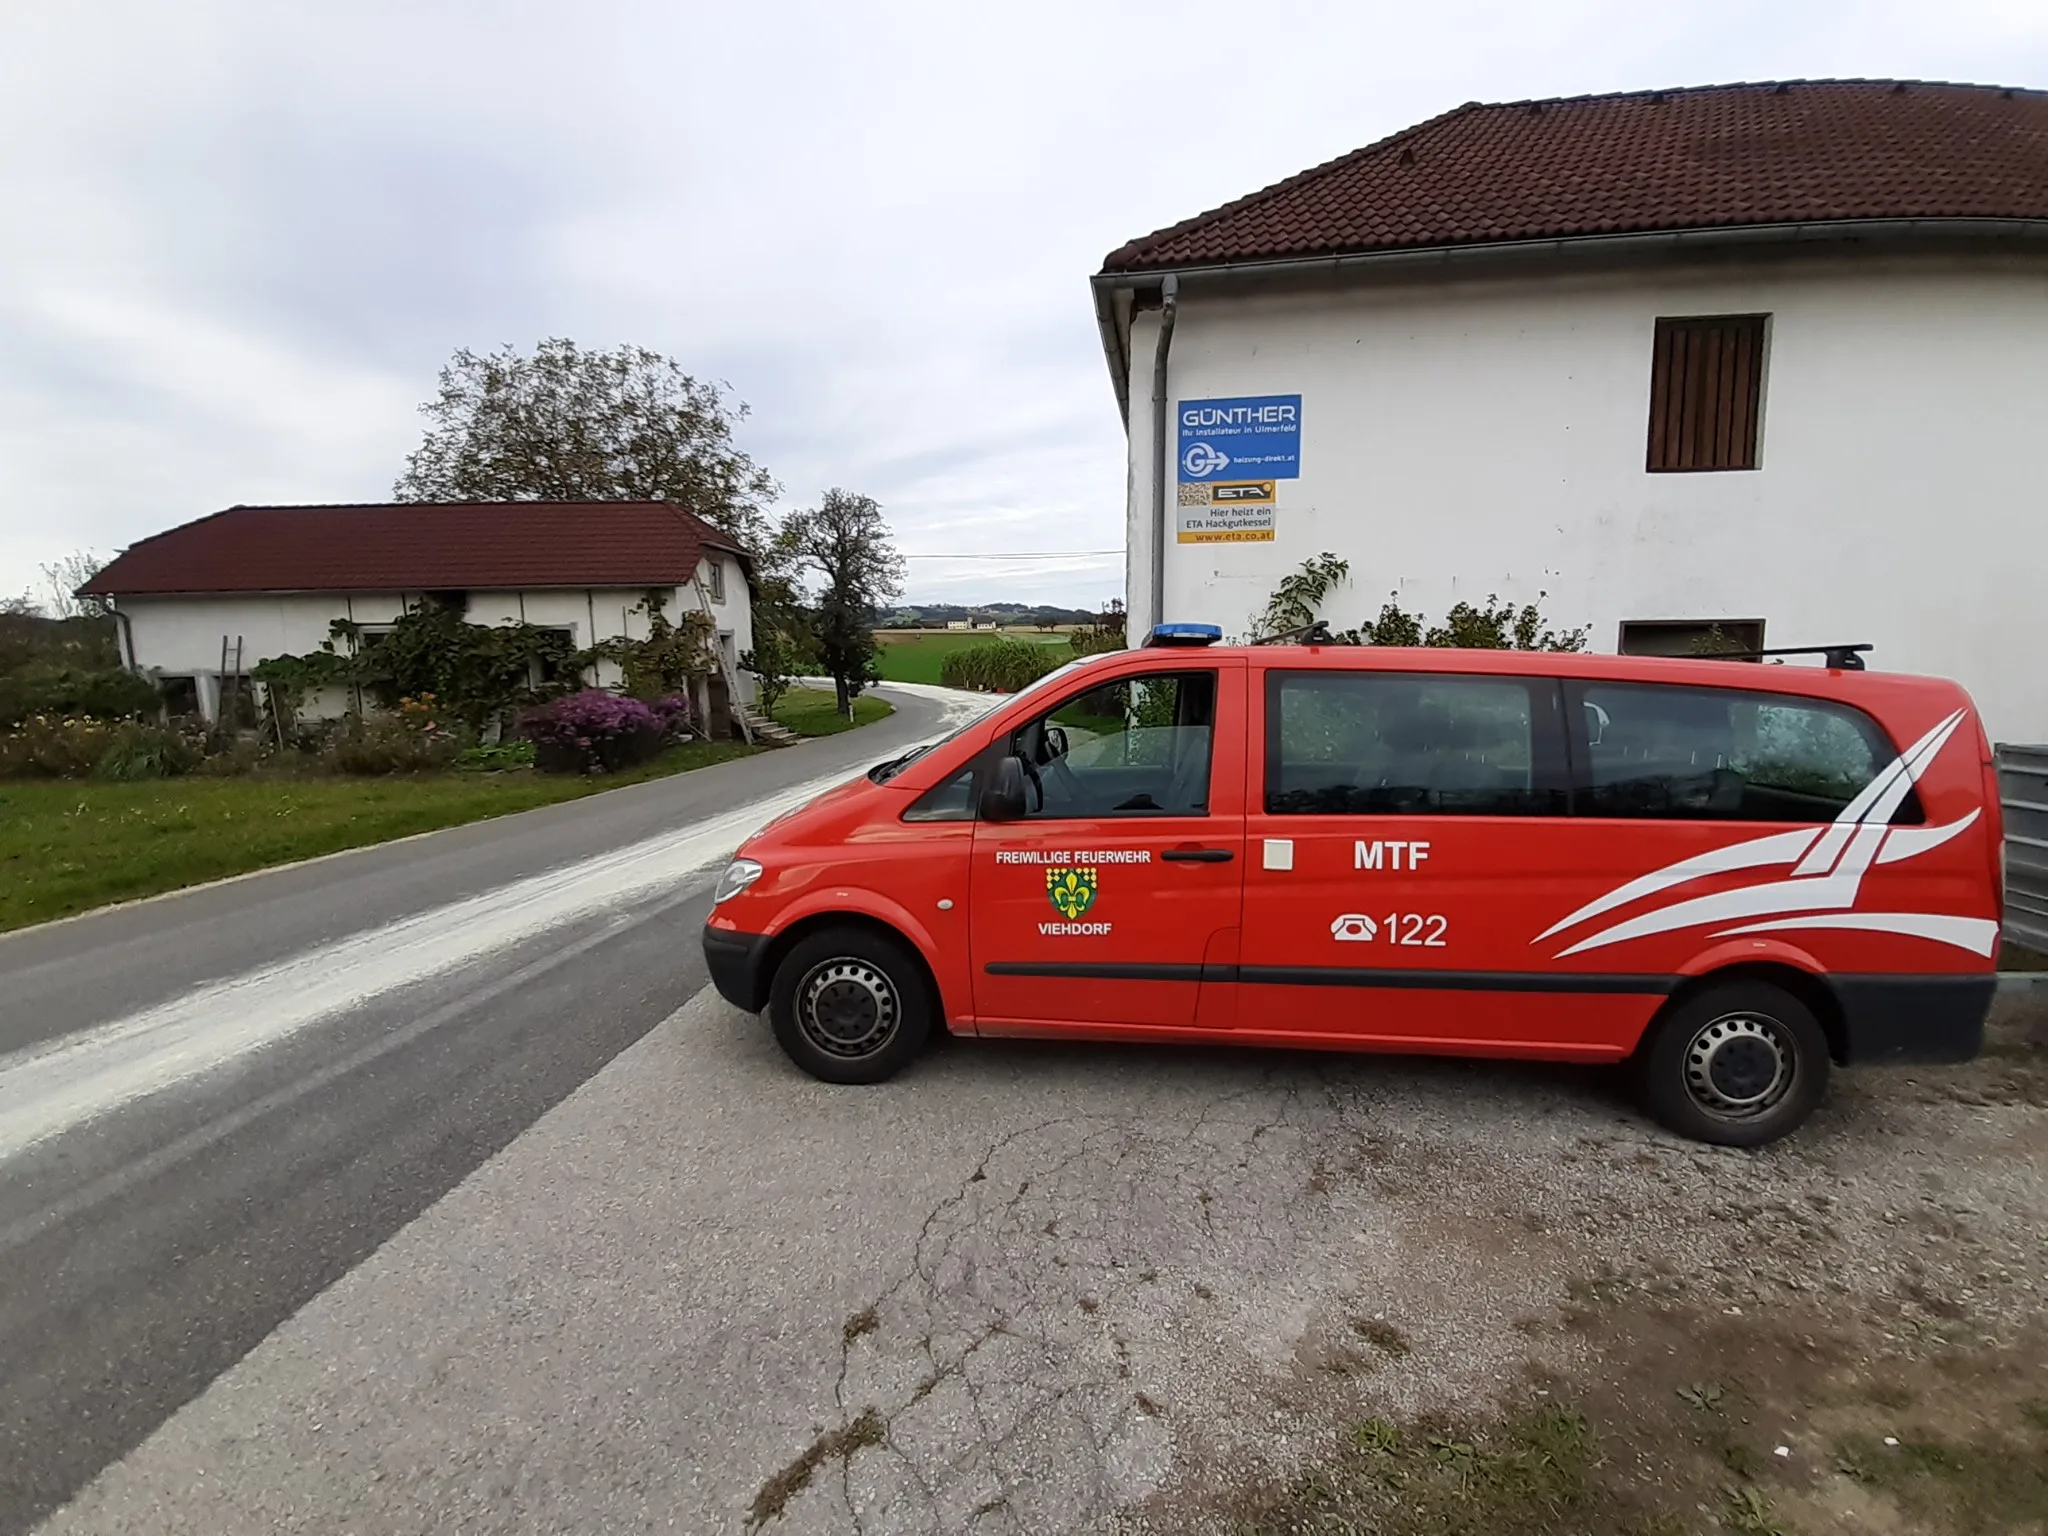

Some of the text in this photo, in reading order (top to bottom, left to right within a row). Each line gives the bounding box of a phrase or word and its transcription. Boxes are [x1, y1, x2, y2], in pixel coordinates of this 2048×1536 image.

[1182, 405, 1296, 427] GÜNTHER
[1182, 429, 1194, 437] Ihr
[1196, 427, 1242, 436] Installateur
[1255, 424, 1296, 433] Ulmerfeld
[1233, 454, 1295, 465] heizung-direkt.at
[1217, 487, 1265, 499] ETA
[1210, 507, 1271, 517] Hier heizt ein
[1186, 517, 1271, 529] ETA Hackgutkessel
[1196, 531, 1271, 542] www.eta.co.at
[996, 851, 1151, 864] FREIWILLIGE FEUERWEHR
[1354, 840, 1430, 870] MTF
[1038, 923, 1112, 935] VIEHDORF
[1383, 912, 1448, 946] 122
